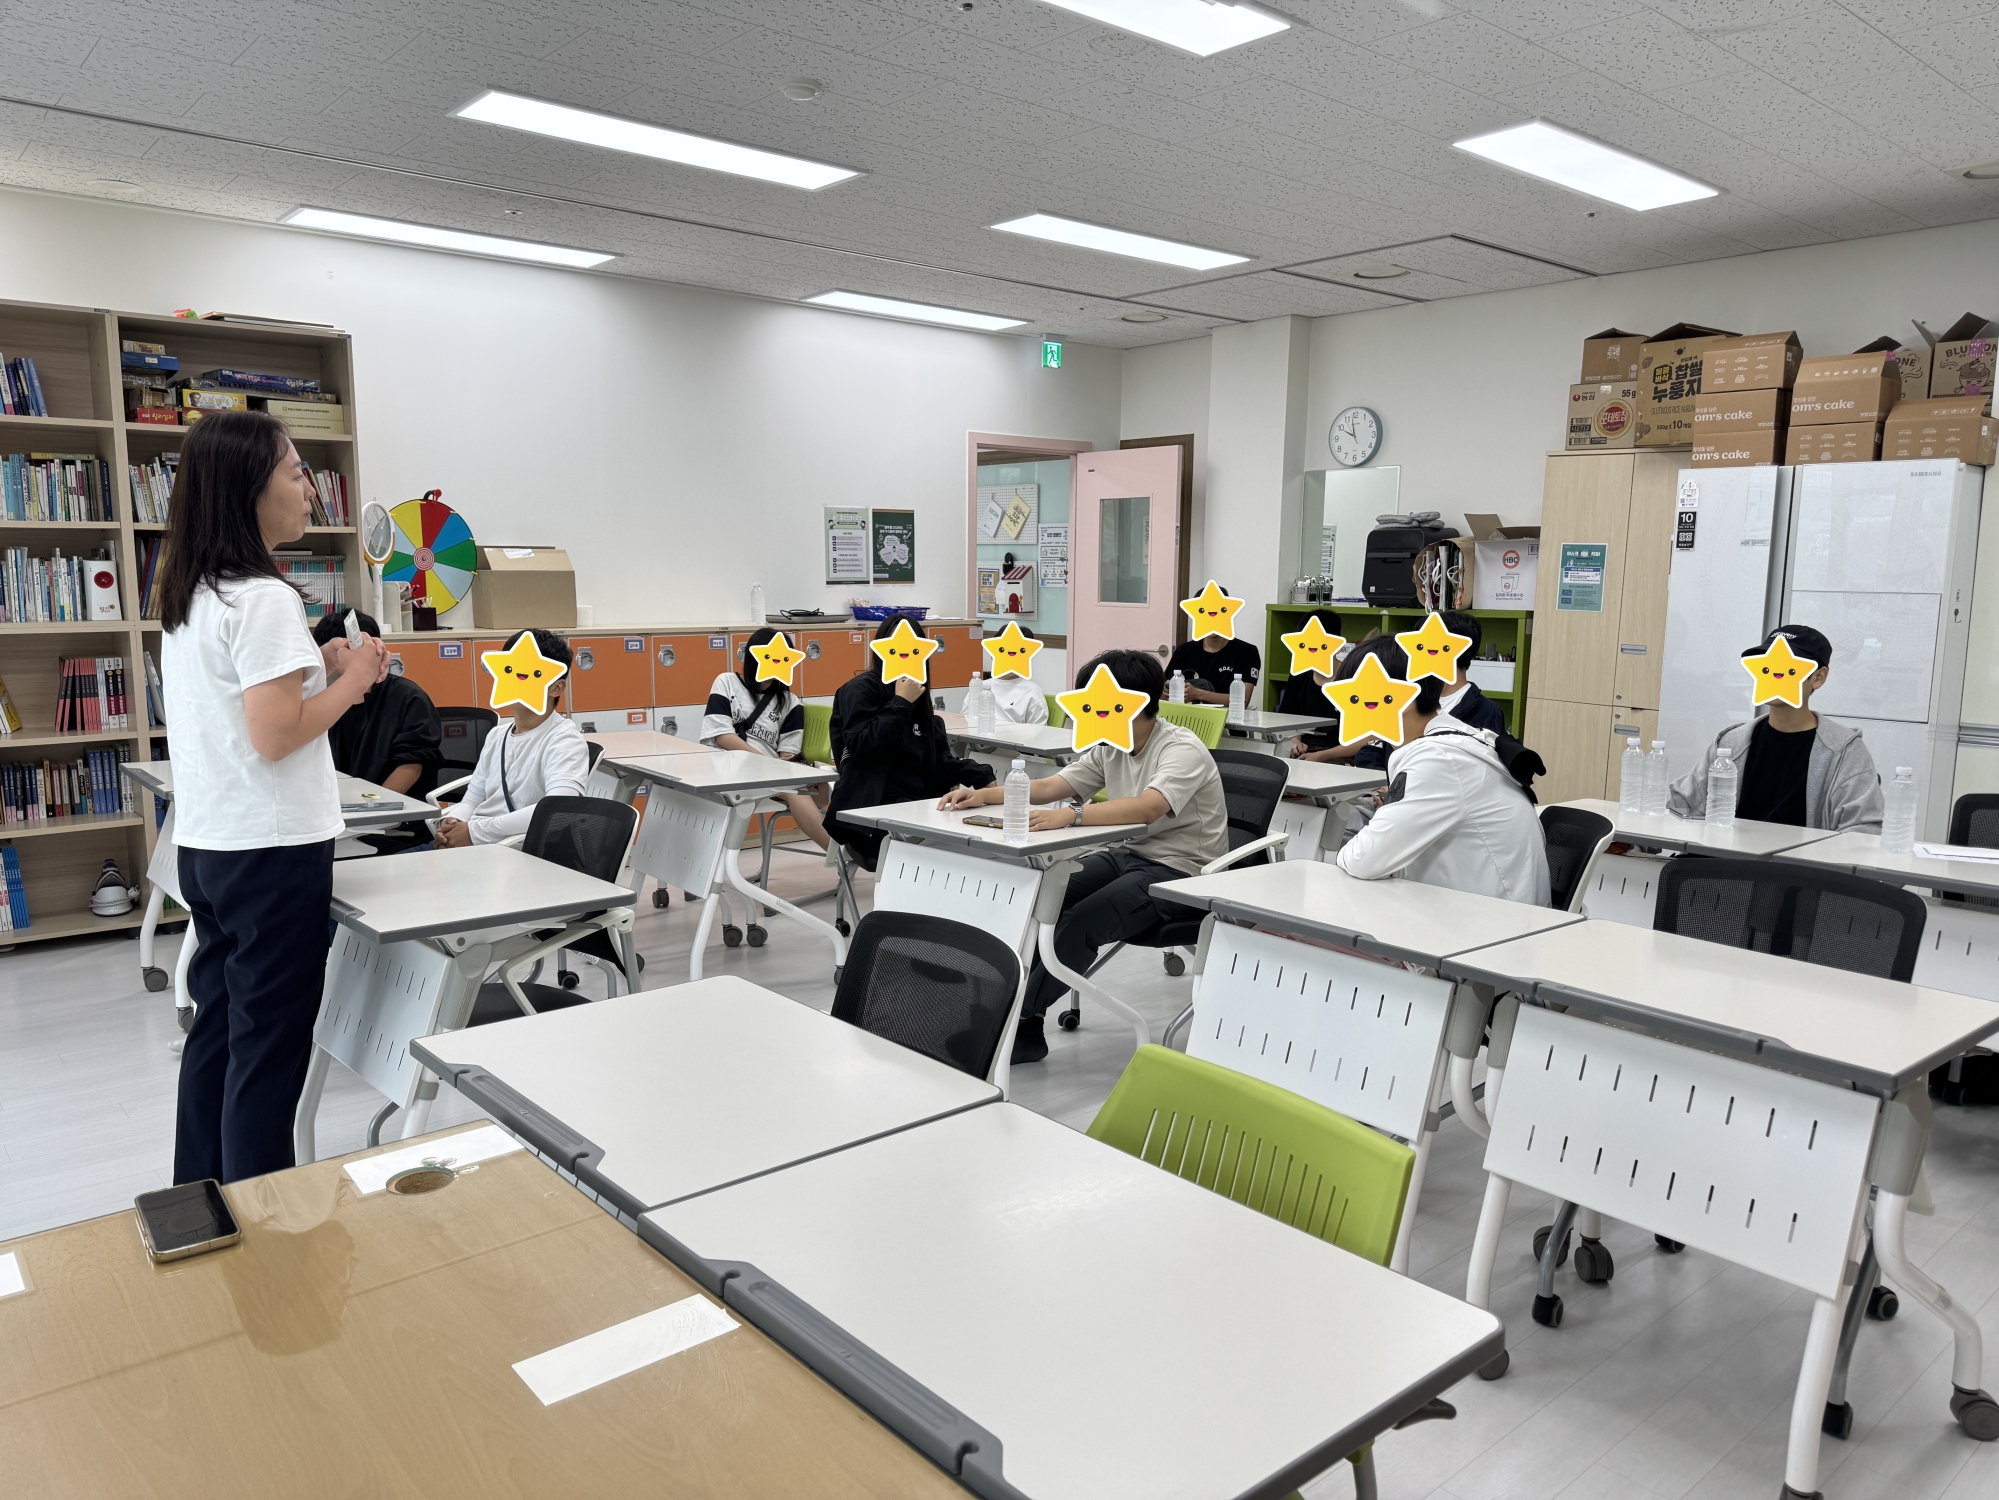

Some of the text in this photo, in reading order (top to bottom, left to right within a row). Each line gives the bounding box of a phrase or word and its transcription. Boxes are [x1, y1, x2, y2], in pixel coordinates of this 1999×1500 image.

[1652, 377, 1702, 403] 누룽지
[1824, 399, 1855, 410] cake
[1724, 410, 1753, 420] cake
[1721, 449, 1750, 460] cake
[1680, 513, 1694, 523] 10
